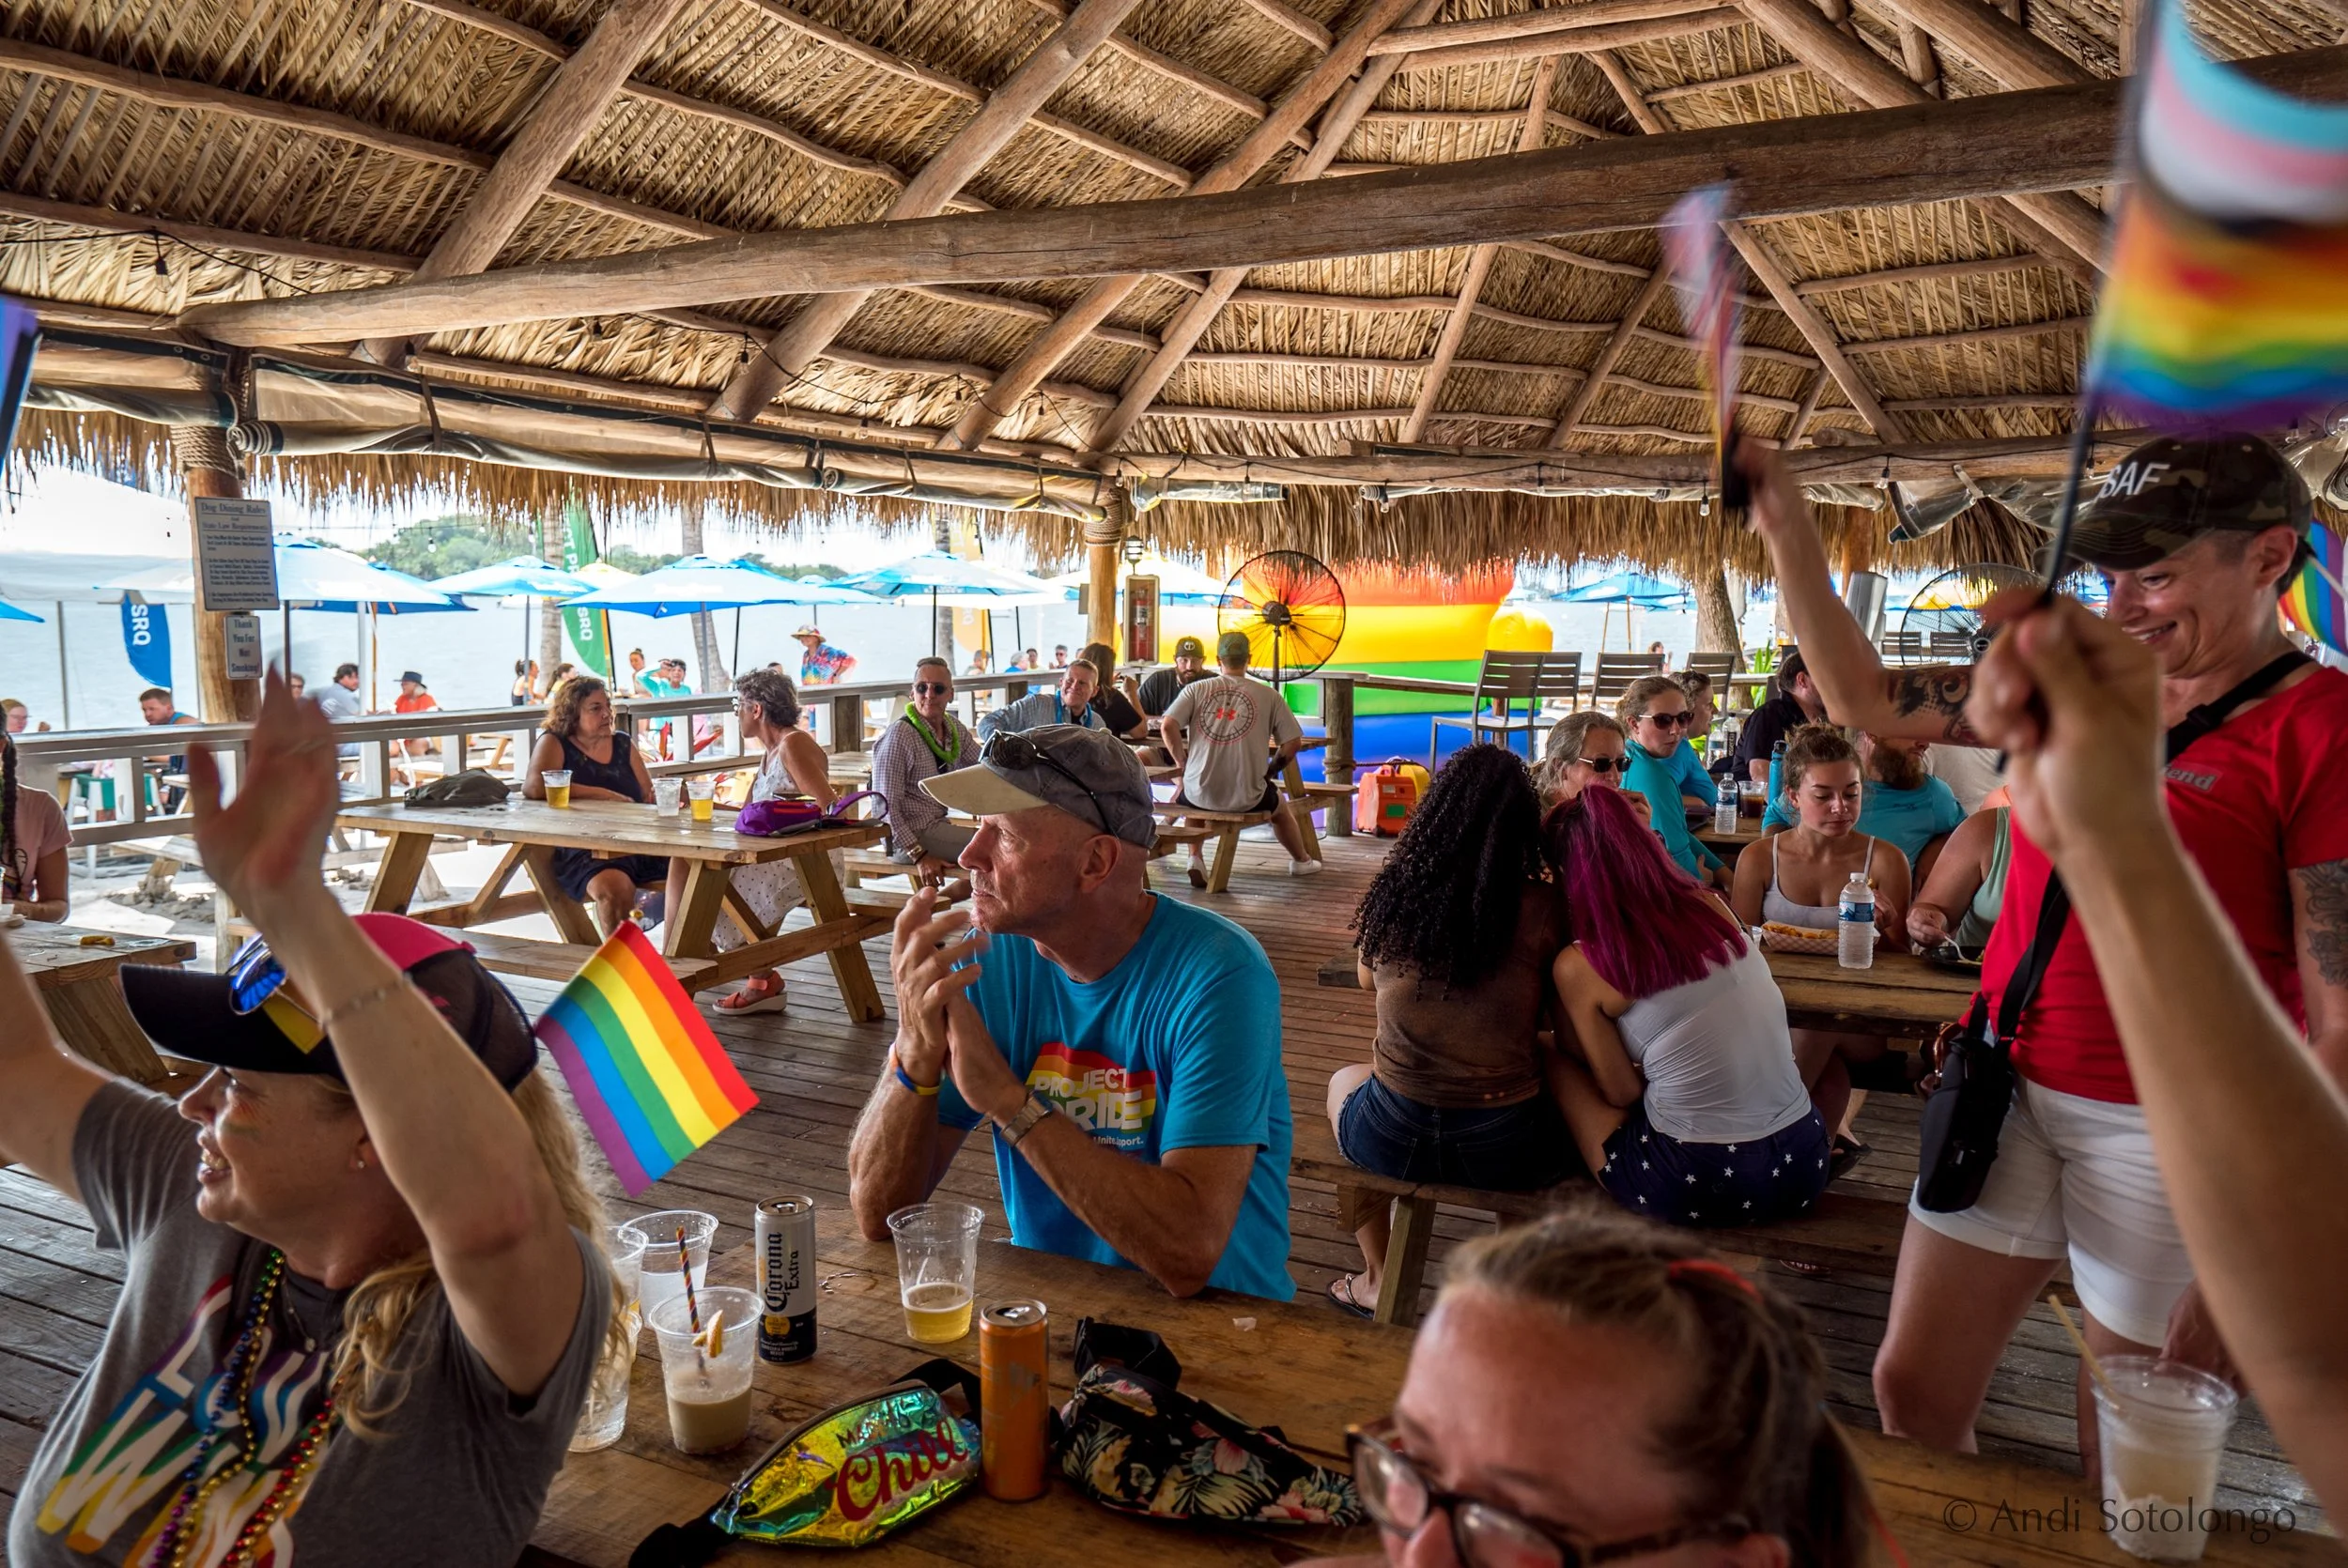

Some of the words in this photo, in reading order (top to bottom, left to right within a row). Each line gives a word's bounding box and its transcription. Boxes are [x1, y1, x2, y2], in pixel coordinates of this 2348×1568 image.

[2094, 460, 2170, 500] SAF
[131, 604, 151, 646] SRQ
[234, 619, 253, 628] Thank
[577, 606, 594, 641] SRQ
[765, 1232, 788, 1313] Corona
[784, 1251, 800, 1296] Extra
[143, 1273, 331, 1465] LOV
[824, 1418, 970, 1522] Chill
